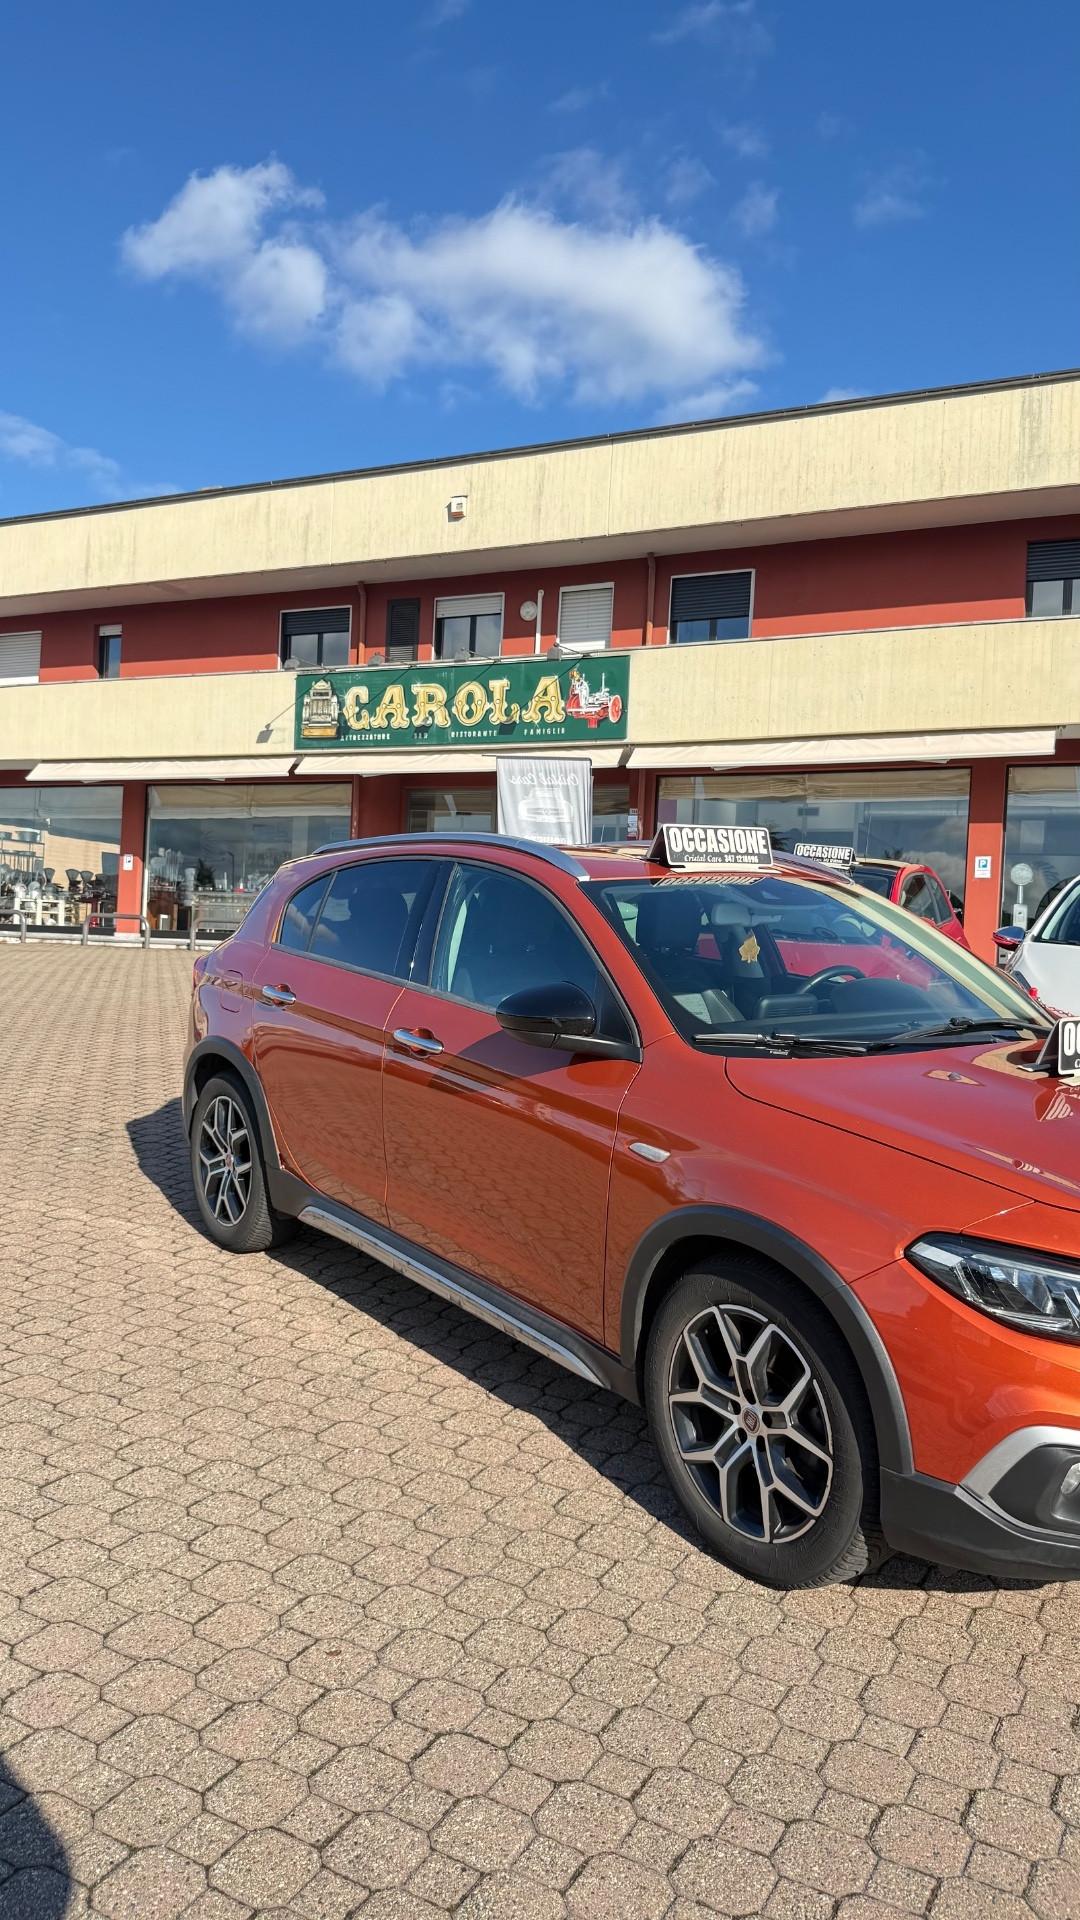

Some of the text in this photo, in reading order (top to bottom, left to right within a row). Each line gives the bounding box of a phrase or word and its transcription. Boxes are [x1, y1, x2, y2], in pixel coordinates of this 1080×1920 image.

[343, 675, 566, 730] CAROLA
[340, 733, 391, 741] ATTREZZATURE
[450, 730, 498, 738] RISTORANTE
[668, 827, 768, 855] OCCASIONE
[796, 845, 851, 860] OCCASIONE
